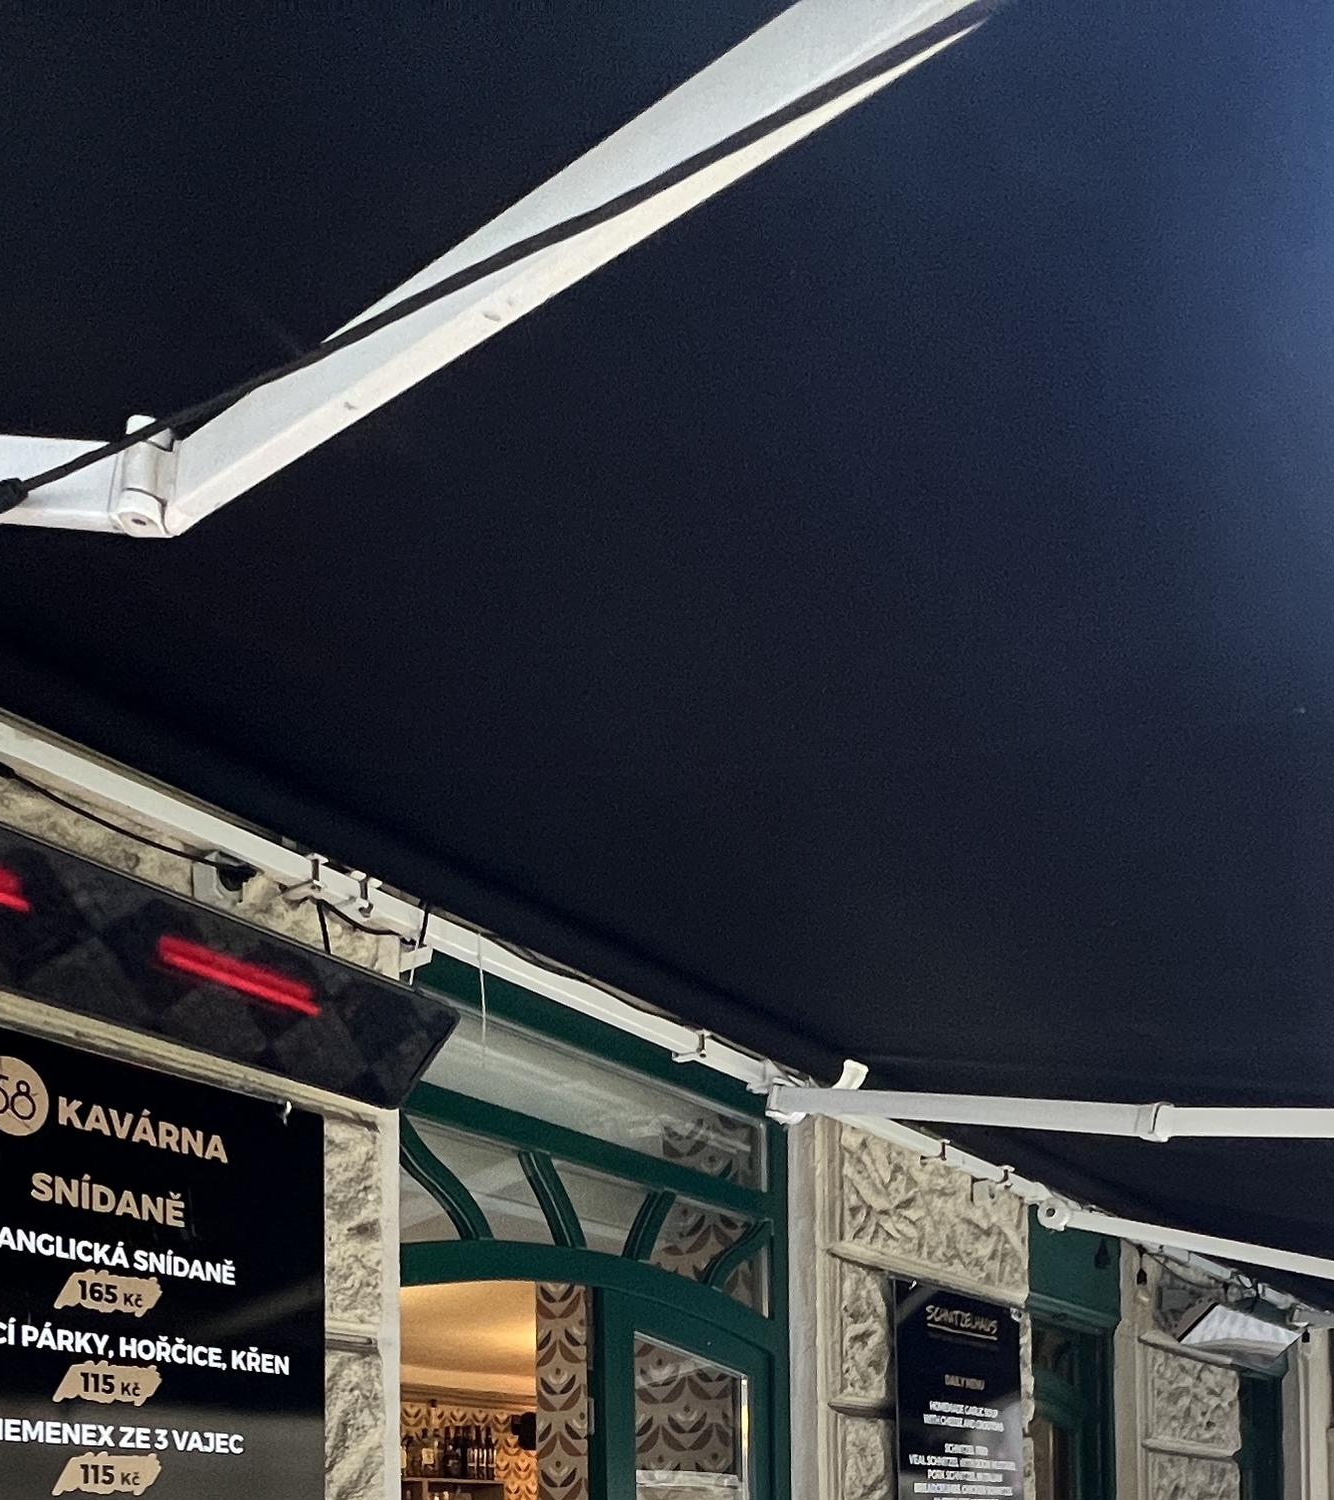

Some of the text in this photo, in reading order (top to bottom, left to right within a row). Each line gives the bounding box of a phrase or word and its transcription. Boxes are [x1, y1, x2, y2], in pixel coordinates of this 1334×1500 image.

[58, 1095, 229, 1164] KAVÁRNA
[30, 1172, 185, 1228] SNÍDANĚ
[132, 1249, 236, 1286] SNÍDANĚ
[77, 1280, 143, 1309] 165 Kč
[21, 1321, 115, 1359] PÁRKY,
[118, 1335, 227, 1371] HOŘČICE,
[231, 1346, 290, 1376] KŘEN
[80, 1372, 141, 1397] 115 Kč
[118, 1426, 151, 1449] ZE
[154, 1428, 169, 1450] 3
[171, 1429, 245, 1454] VAJEC
[79, 1463, 140, 1486] 115 Kč
